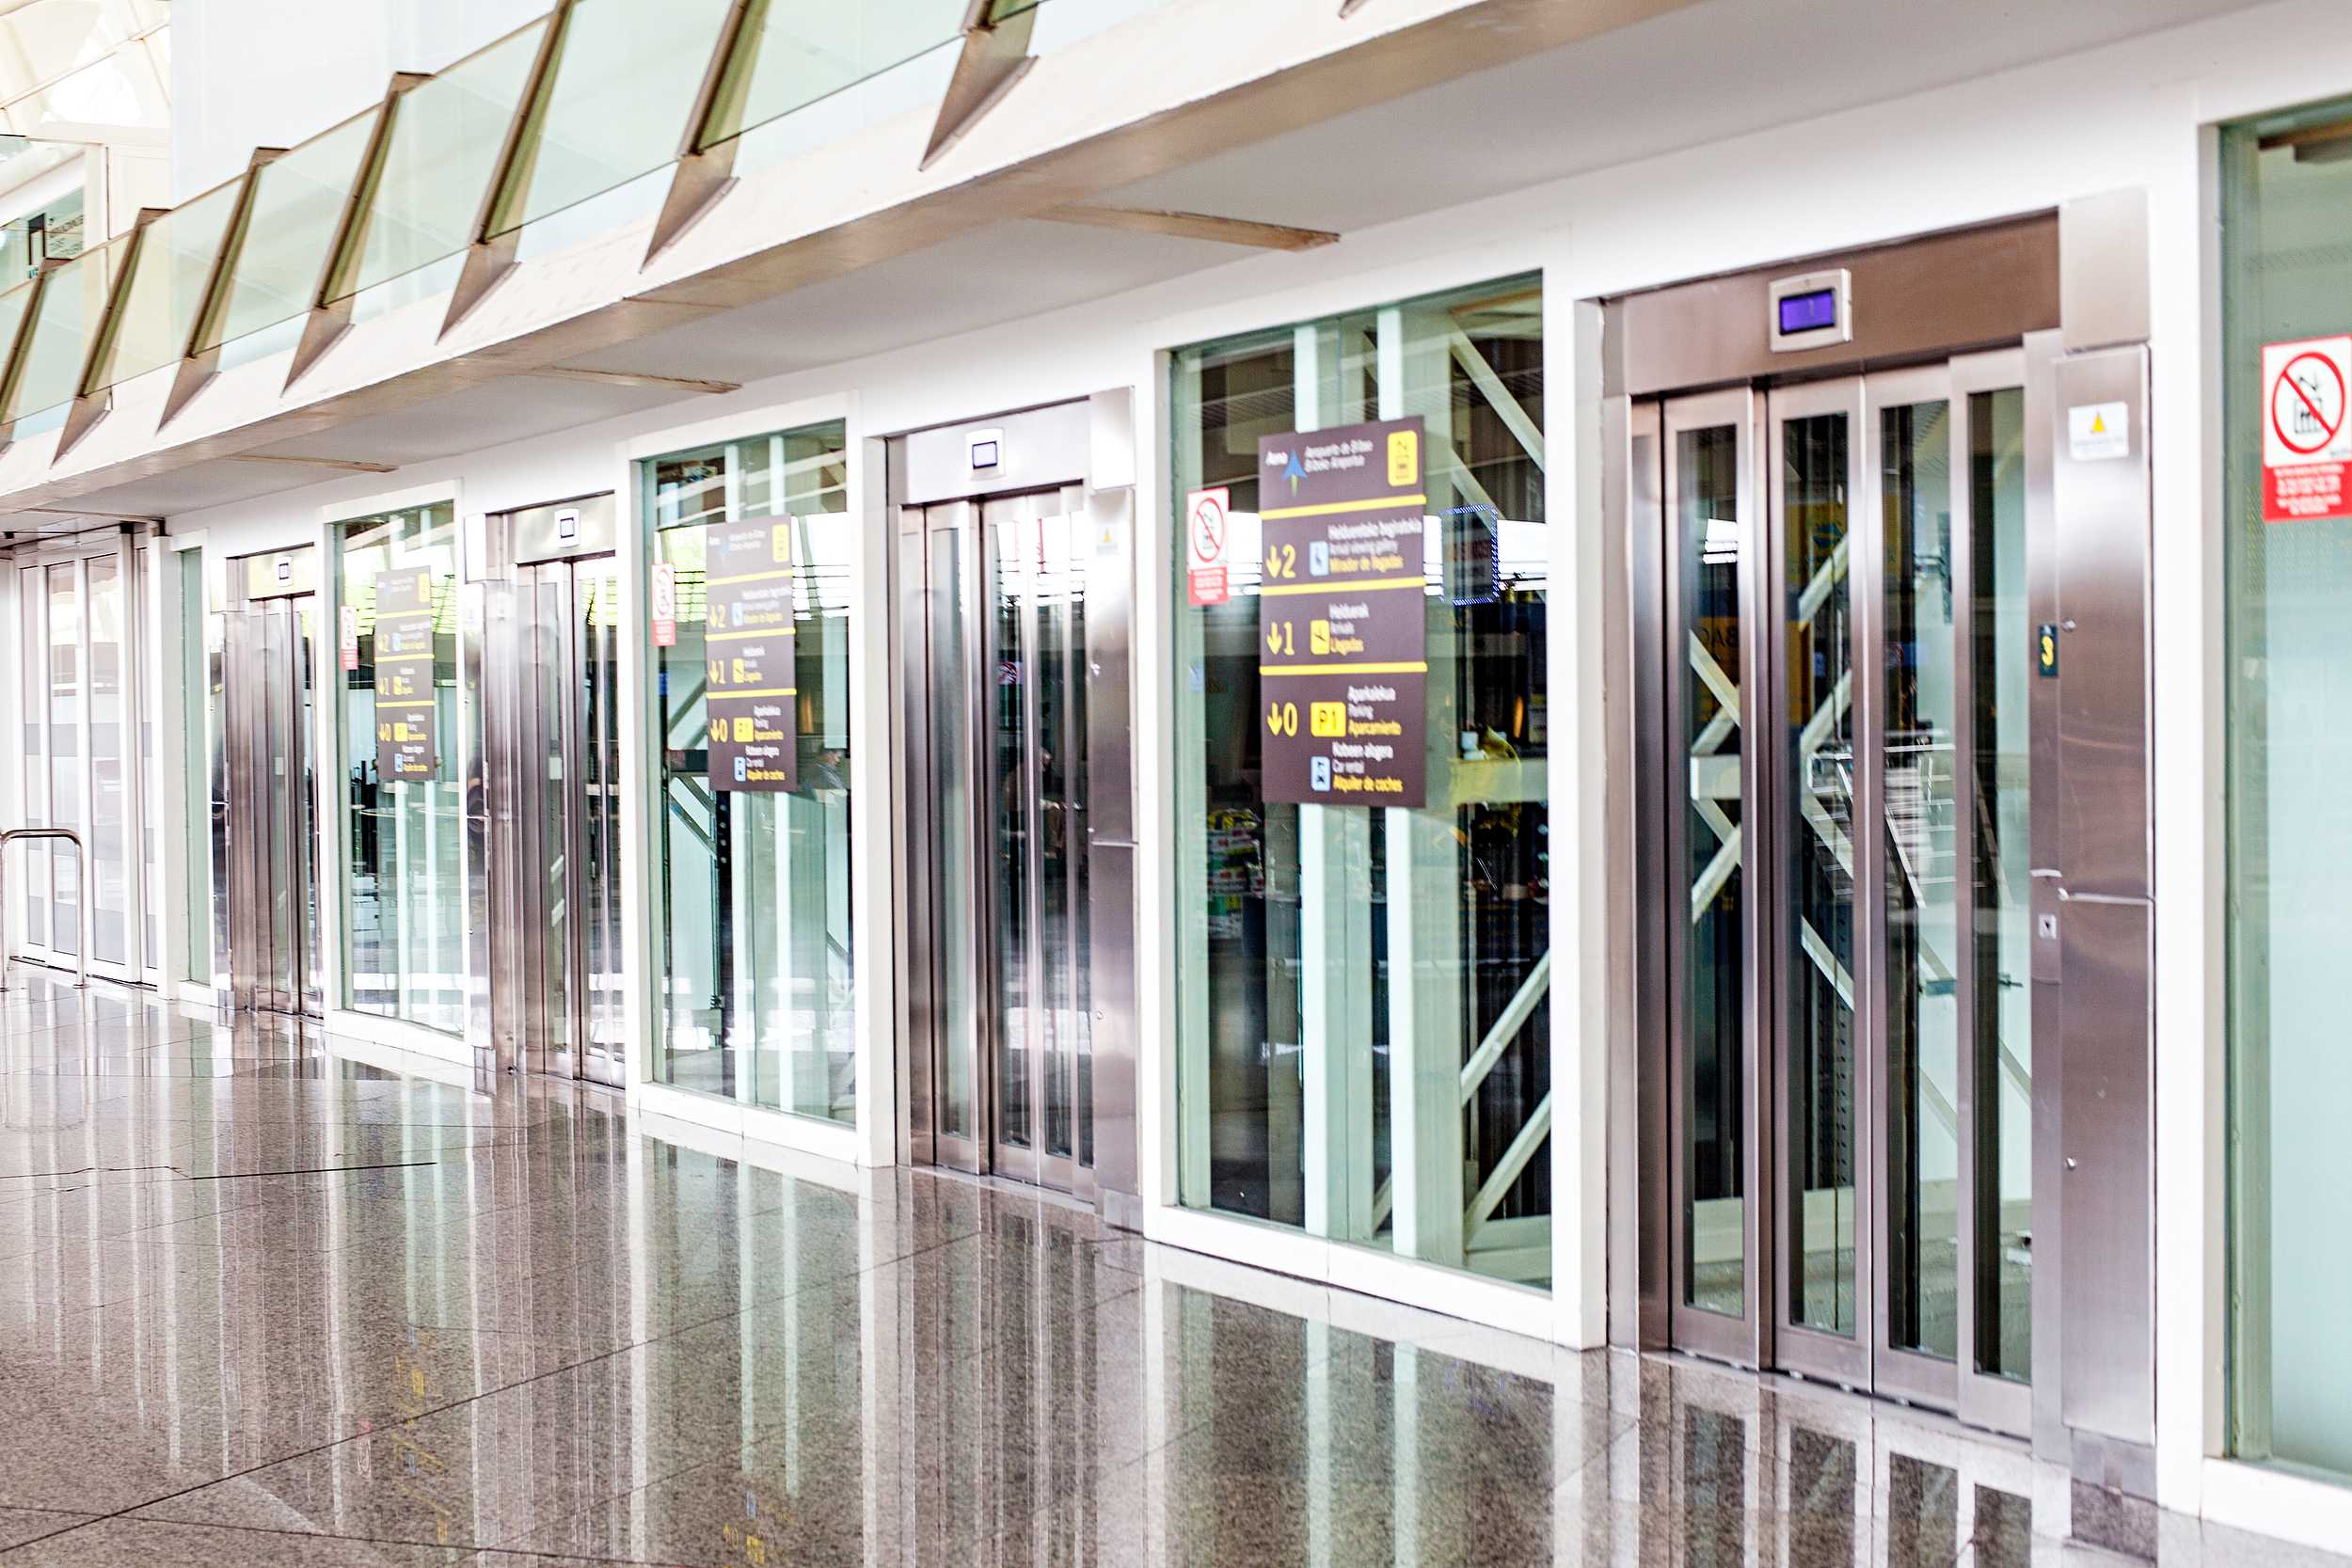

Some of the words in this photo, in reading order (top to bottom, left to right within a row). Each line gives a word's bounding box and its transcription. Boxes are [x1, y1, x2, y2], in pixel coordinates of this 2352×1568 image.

[1281, 544, 1296, 578] 2
[717, 602, 726, 628] 2
[1283, 621, 1295, 656] 1
[1283, 702, 1298, 737] 0
